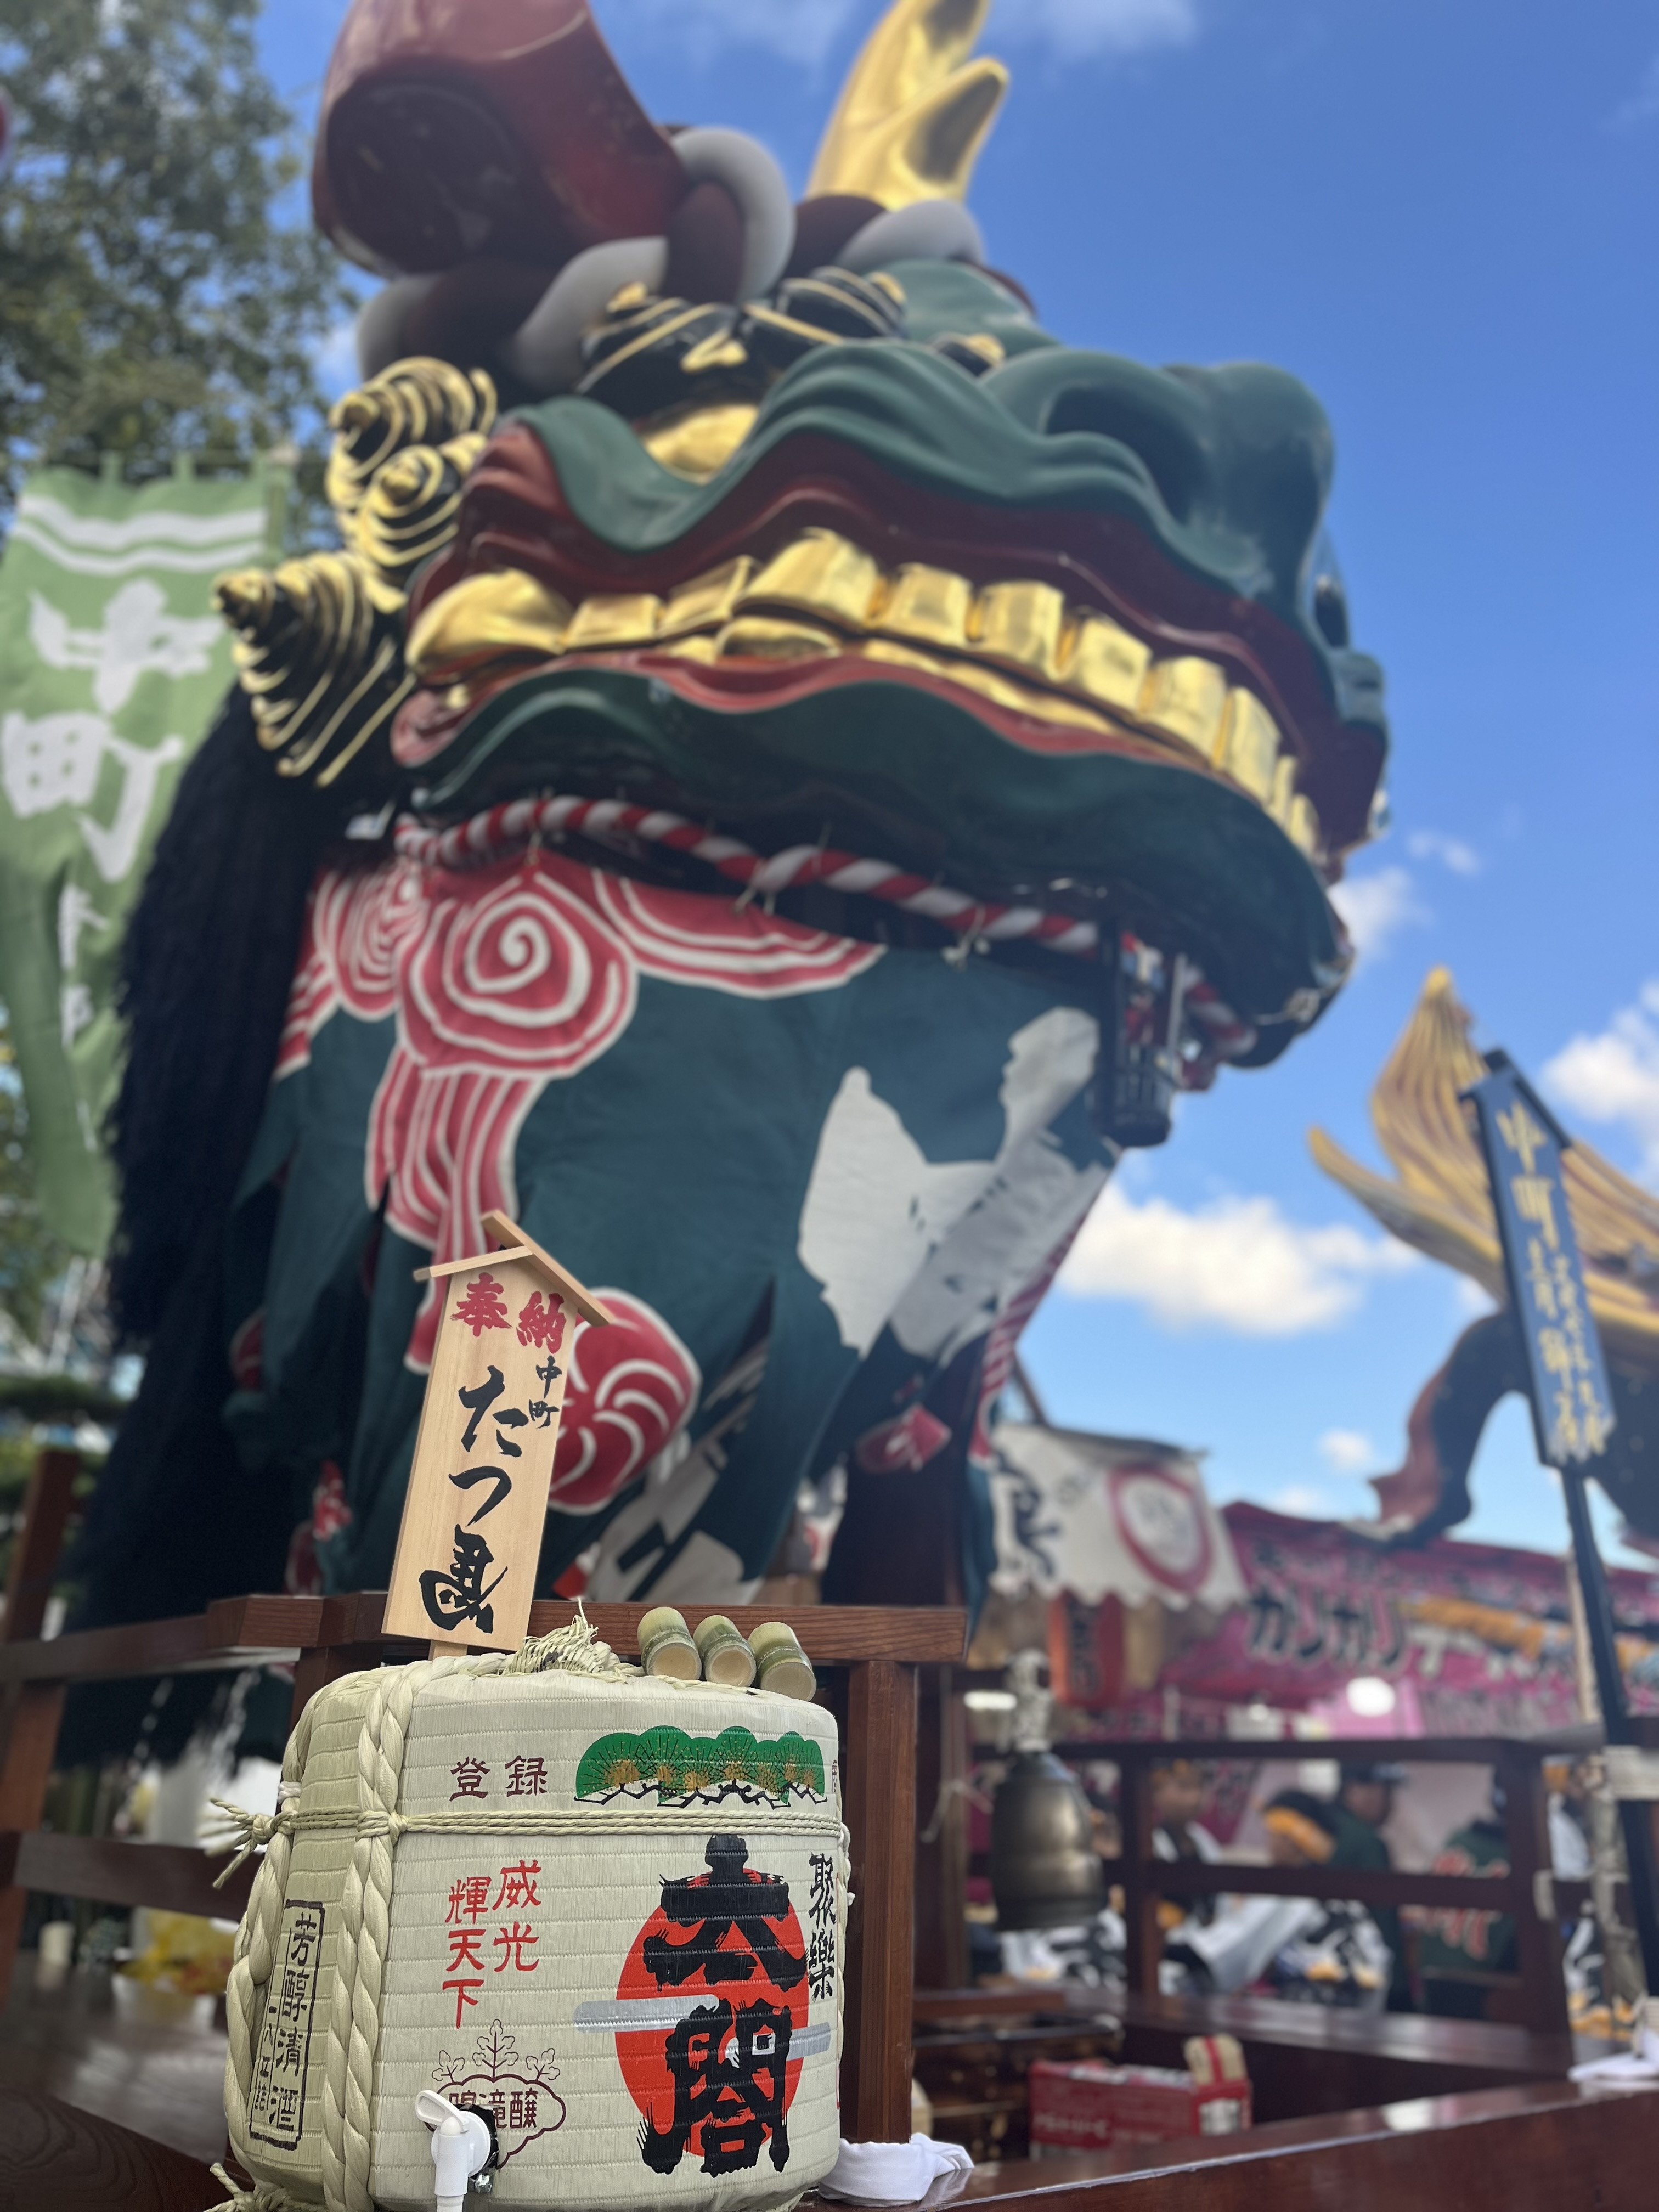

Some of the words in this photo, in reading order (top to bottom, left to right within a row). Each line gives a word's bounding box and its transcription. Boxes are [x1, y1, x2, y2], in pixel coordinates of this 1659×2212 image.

[451, 1272, 567, 1354] 奉納
[528, 1355, 563, 1430] 中町
[449, 1754, 548, 1802] 登録
[442, 1876, 492, 2030] 輝天下
[492, 1860, 541, 1973] 威光
